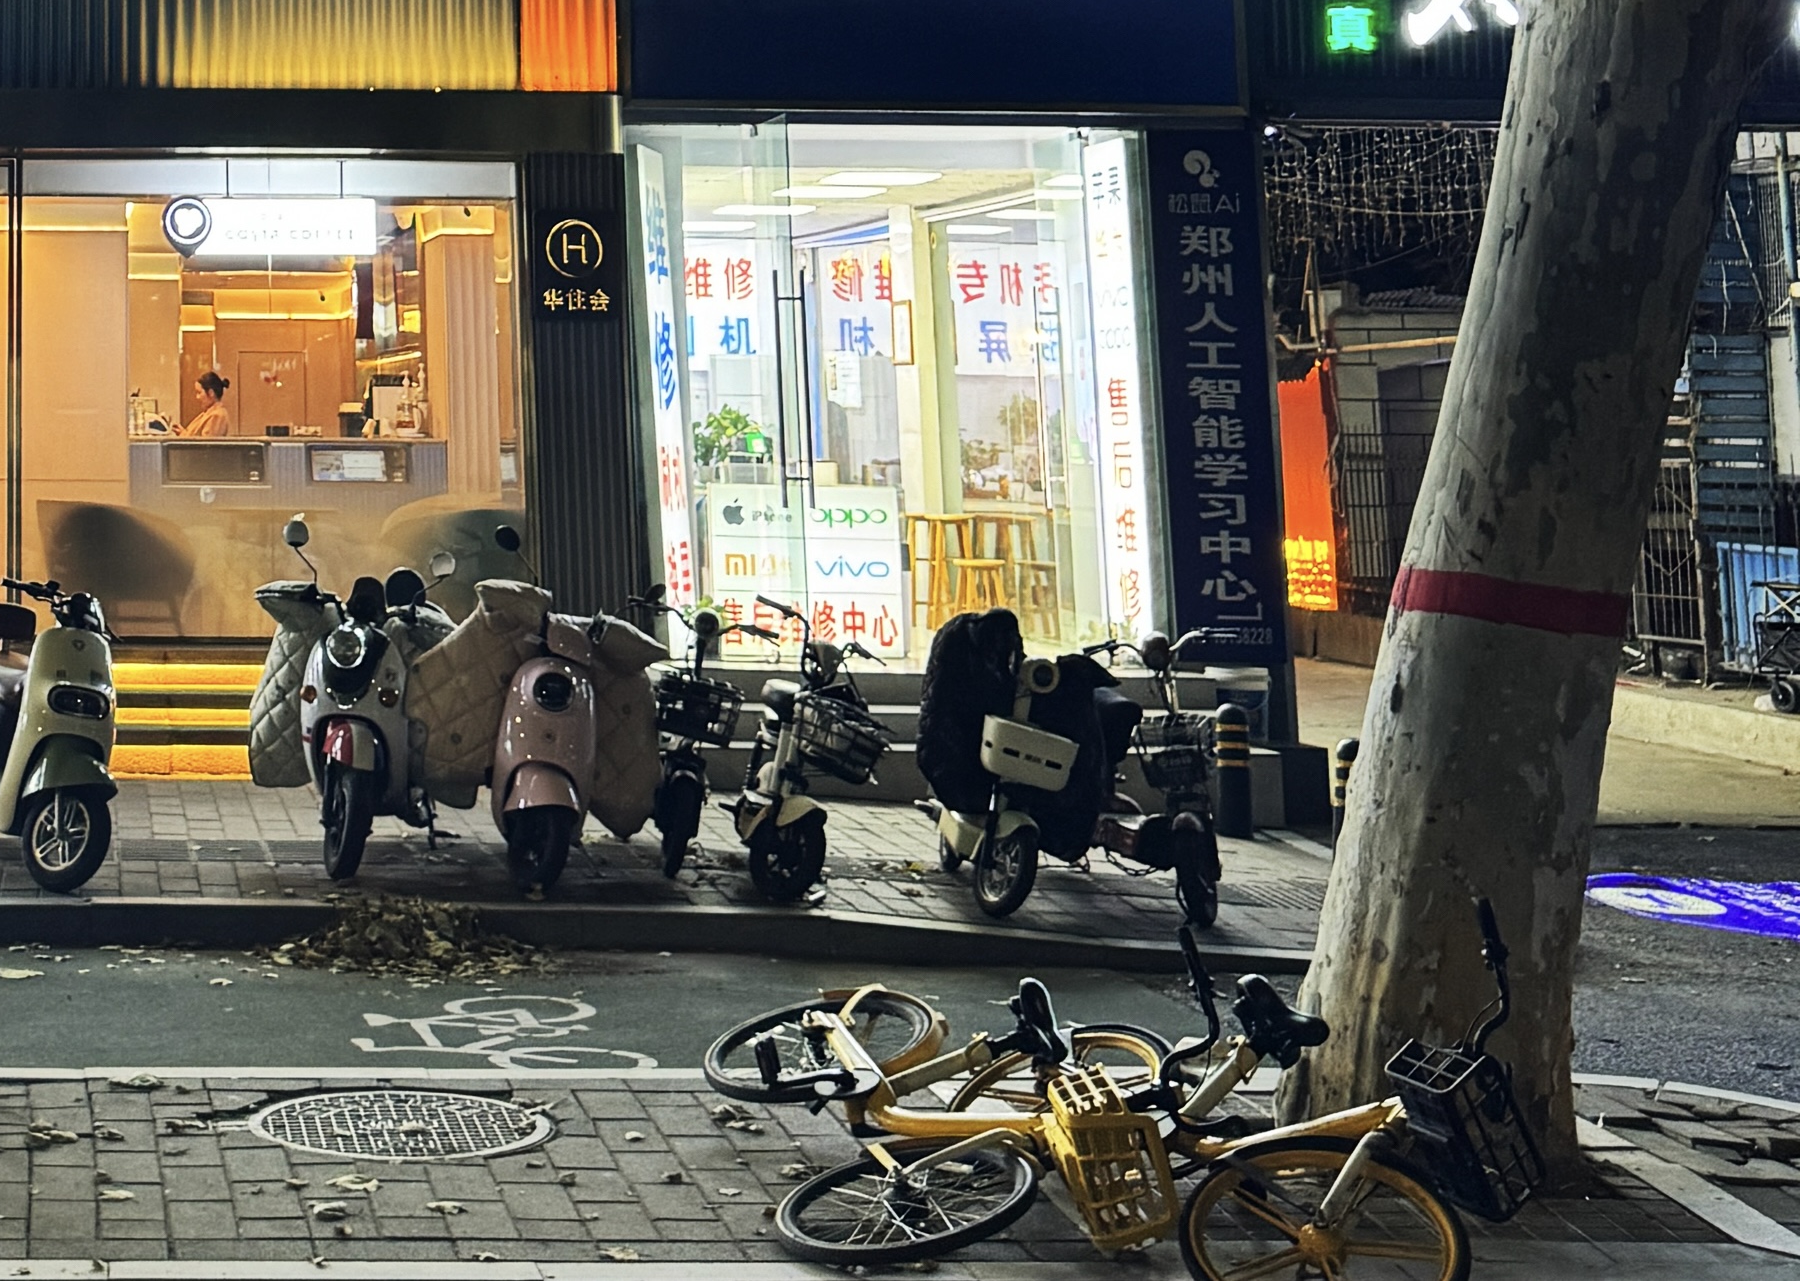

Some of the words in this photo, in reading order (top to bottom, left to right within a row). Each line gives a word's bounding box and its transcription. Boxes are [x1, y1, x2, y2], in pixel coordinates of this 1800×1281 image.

[543, 288, 611, 311] 华住会
[1179, 226, 1258, 601] 郑州人工智能学习中心
[815, 555, 890, 578] vivo
